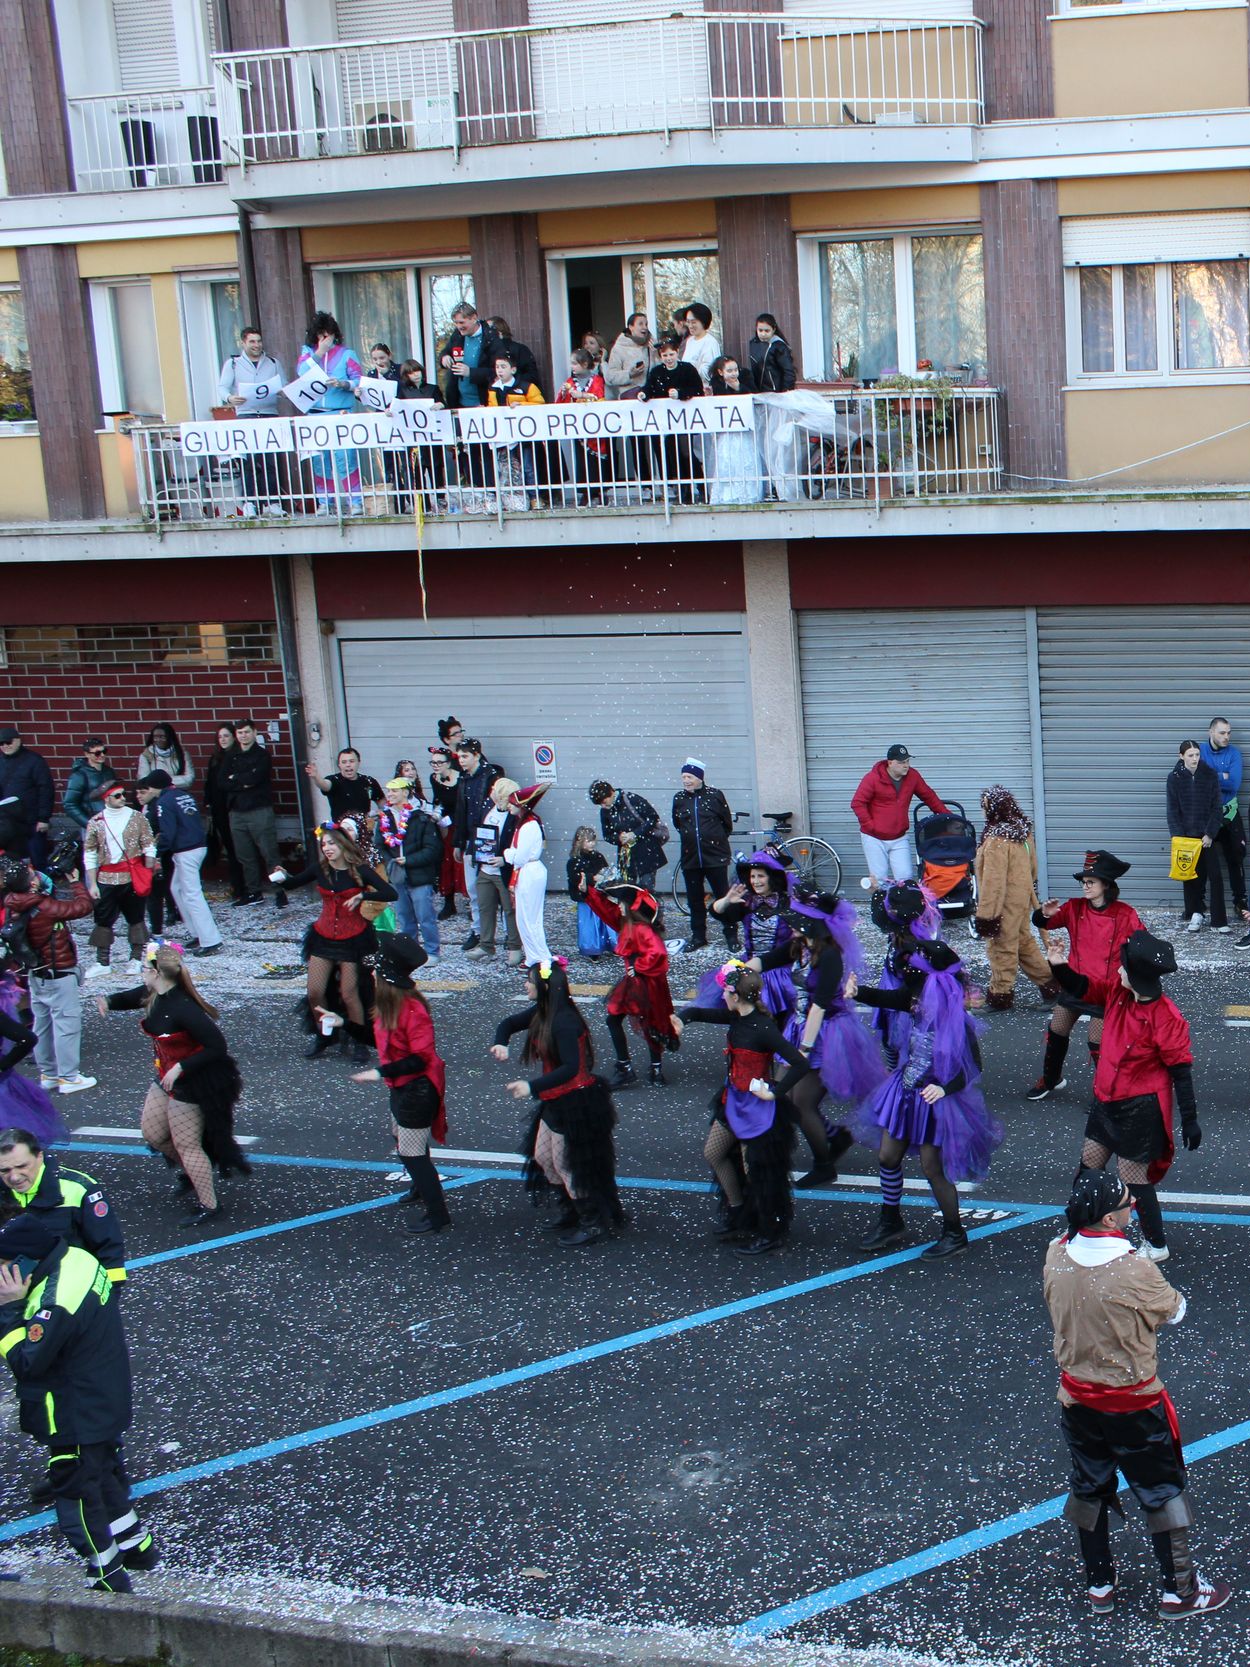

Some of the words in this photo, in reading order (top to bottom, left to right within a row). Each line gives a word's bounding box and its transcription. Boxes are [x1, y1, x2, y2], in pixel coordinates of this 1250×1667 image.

[255, 384, 270, 400] 9
[299, 380, 328, 402] 10
[398, 409, 428, 429] 10
[184, 428, 281, 453] GIURIA
